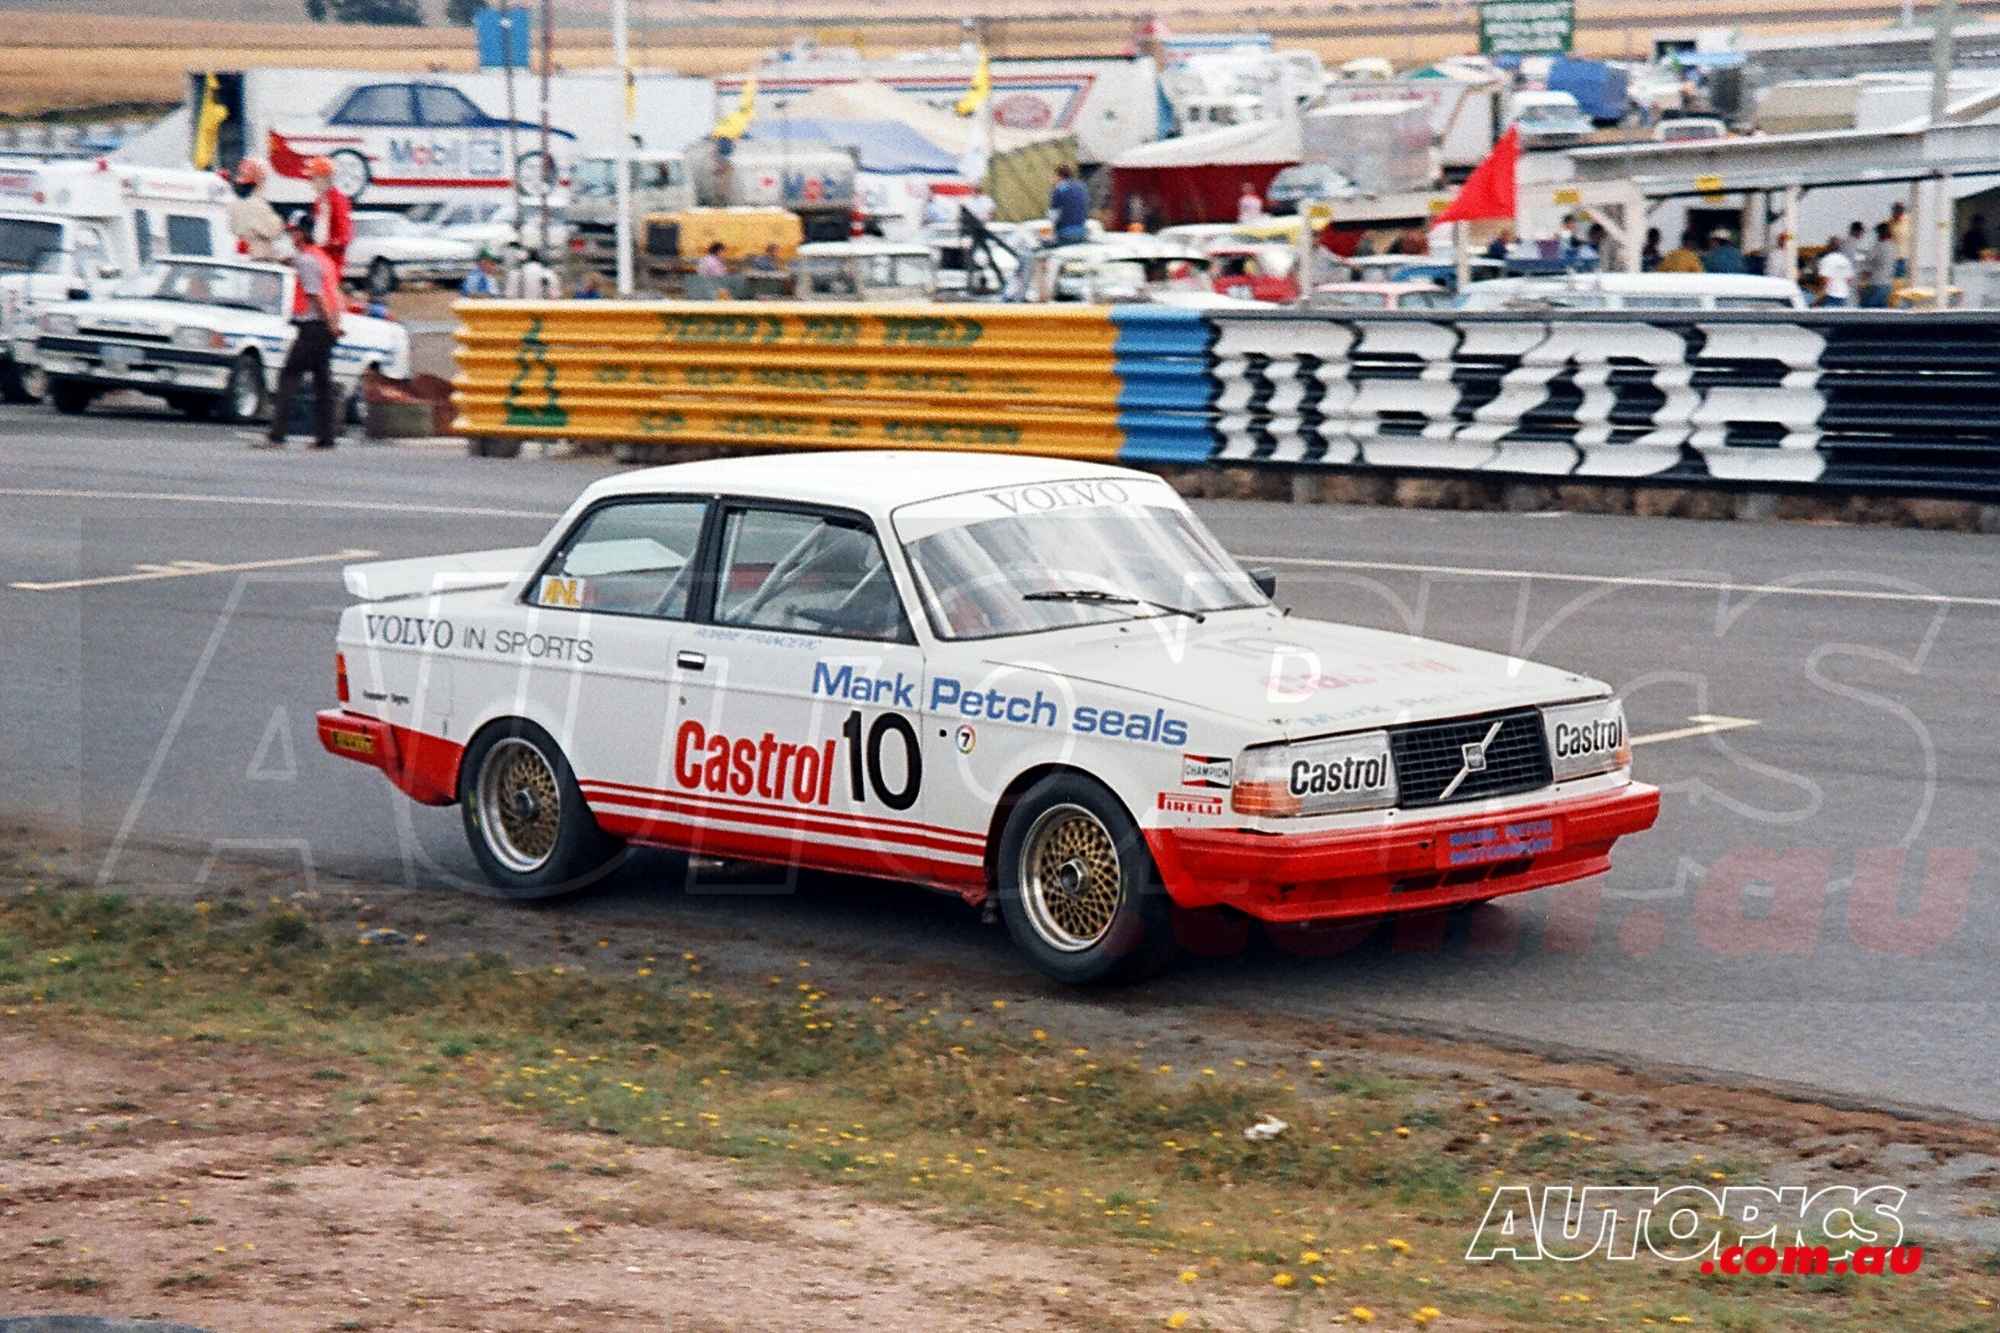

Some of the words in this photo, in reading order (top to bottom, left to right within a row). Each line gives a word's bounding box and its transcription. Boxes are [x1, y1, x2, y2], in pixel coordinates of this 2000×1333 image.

[983, 480, 1129, 513] VOLVO
[365, 614, 454, 650] VOLVO
[463, 626, 486, 651] IN
[495, 628, 595, 664] SPORTS
[811, 661, 914, 709] Mark
[928, 677, 1058, 728] Petch
[1071, 708, 1190, 747] seals
[1555, 715, 1624, 759] Castrol
[674, 719, 837, 806] Castrol
[842, 709, 923, 811] 10
[1184, 761, 1230, 780] CHAMPION
[1289, 752, 1388, 797] Castrol
[1158, 791, 1223, 816] PIRELLI
